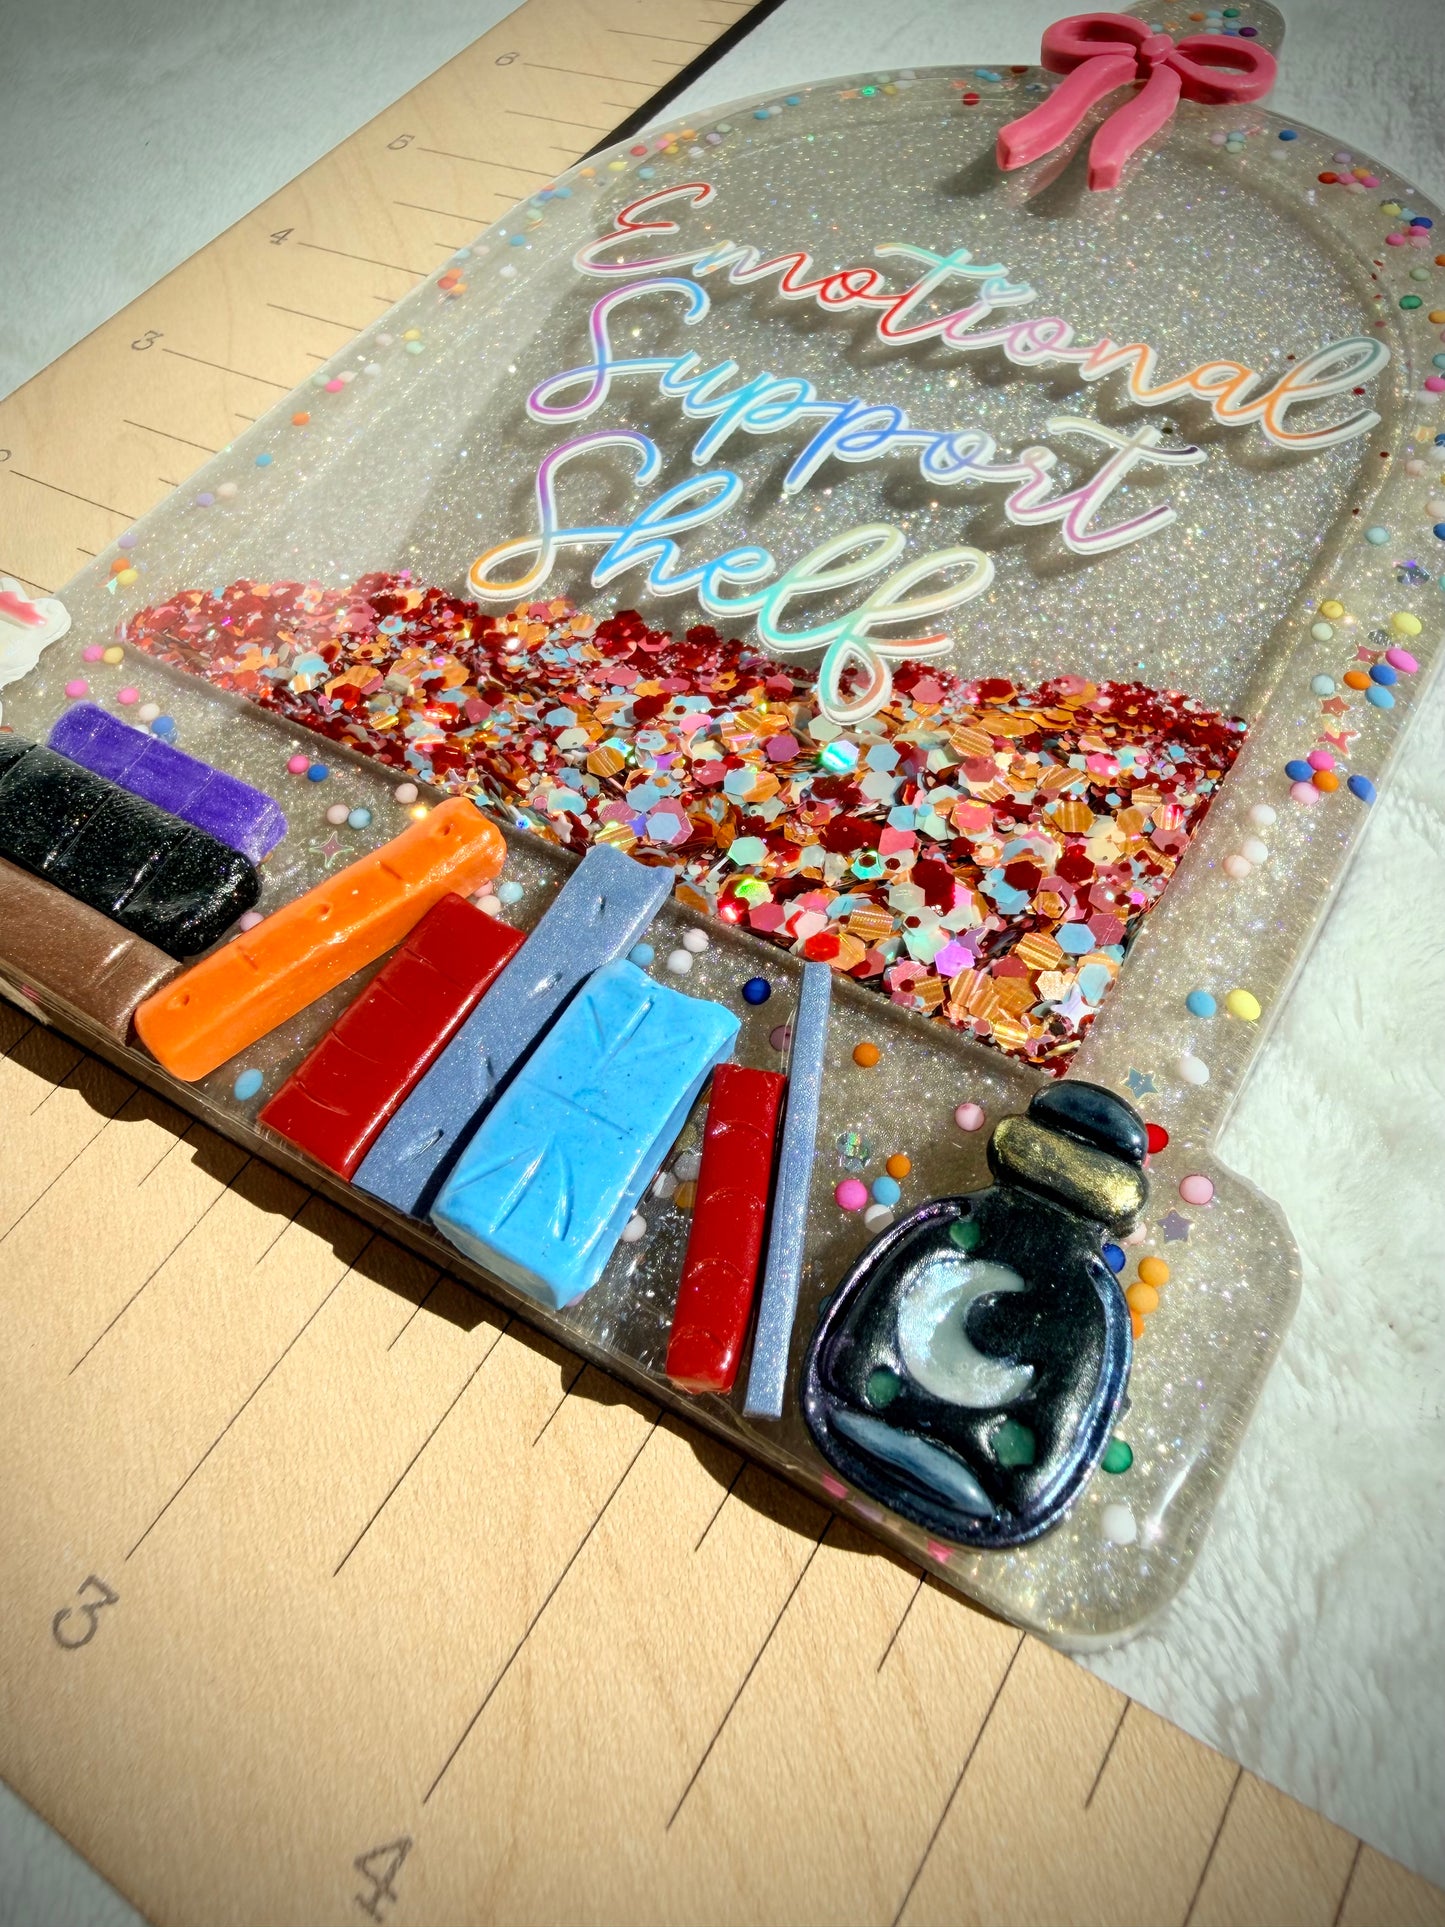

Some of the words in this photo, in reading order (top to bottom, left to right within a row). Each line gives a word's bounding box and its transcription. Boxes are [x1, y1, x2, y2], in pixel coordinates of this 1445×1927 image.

[495, 51, 521, 66] 6
[386, 134, 415, 151] 5
[269, 228, 295, 246] 4
[130, 330, 165, 351] 3
[575, 183, 1388, 448] Emotional
[527, 277, 1204, 554] Support
[467, 430, 995, 724] Shelf
[52, 1575, 120, 1650] 3
[354, 1836, 413, 1923] 4
